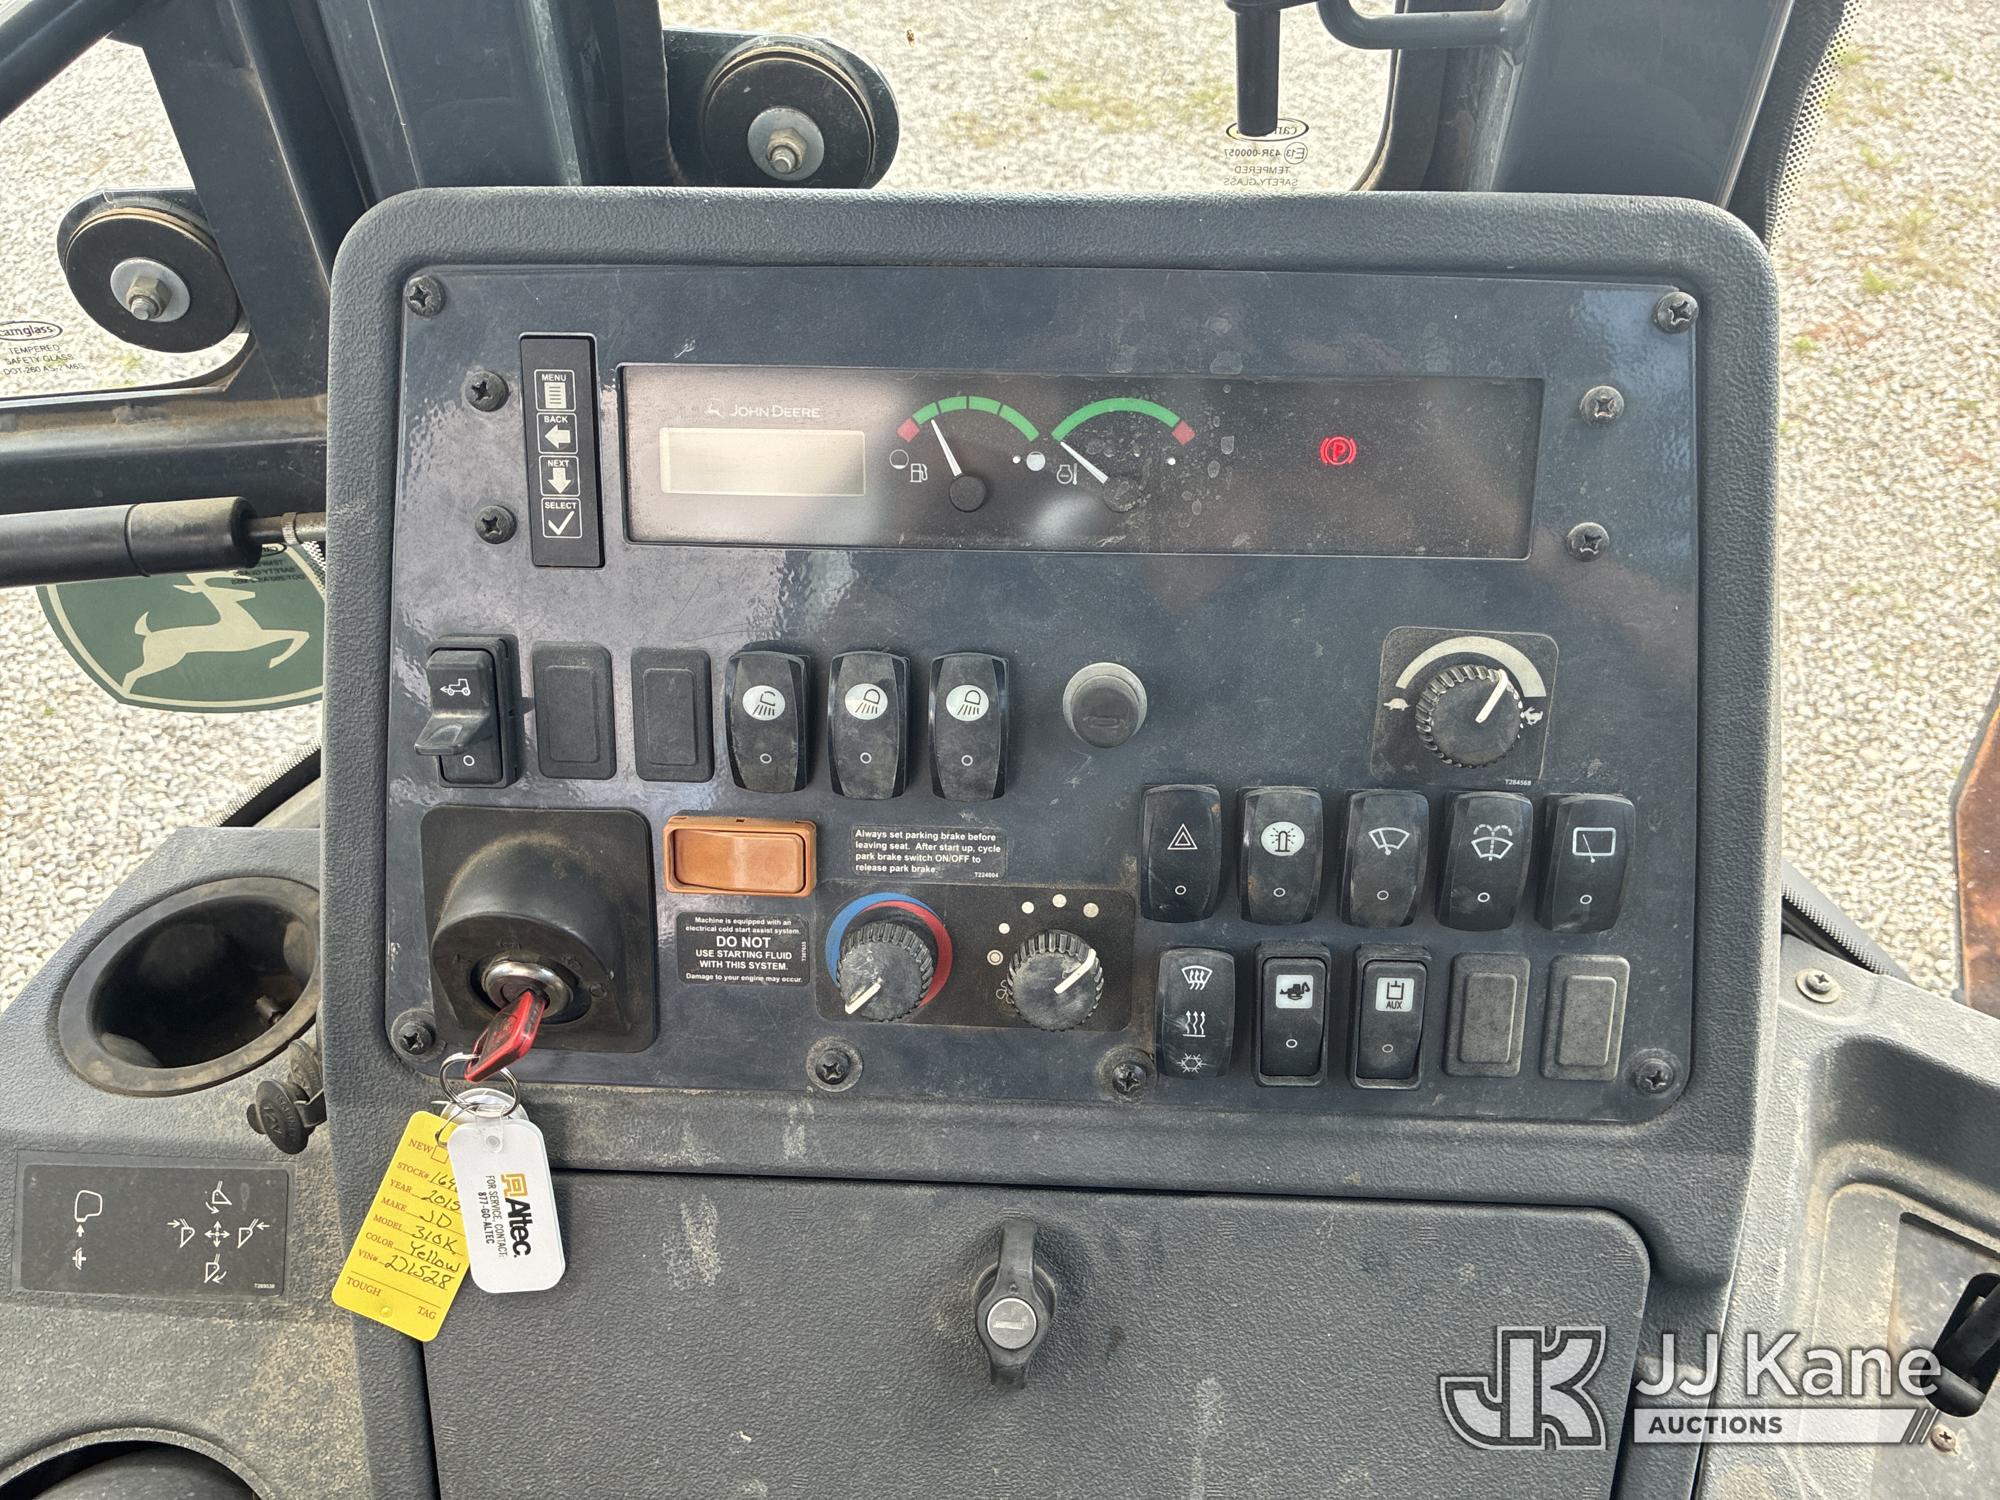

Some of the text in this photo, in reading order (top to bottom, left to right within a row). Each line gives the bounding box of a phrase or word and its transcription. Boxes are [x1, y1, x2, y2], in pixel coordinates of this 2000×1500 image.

[8, 344, 60, 355] TEMPERED
[5, 354, 74, 365] SAFETY GLASS
[542, 374, 567, 382] MENU
[544, 415, 568, 424] BACK
[548, 460, 569, 468] NEXT
[544, 502, 577, 510] SELECT
[855, 829, 997, 842] Always set parking brake before
[855, 840, 1001, 853] leaving seat. After start up, cycle
[855, 852, 981, 863] park brake switch ON/OFF to
[855, 864, 937, 873] release park brake.
[694, 916, 723, 924] Machine
[733, 918, 765, 926] equipped
[752, 926, 773, 934] assist
[774, 927, 801, 936] system.
[716, 935, 771, 948] DO NOT
[695, 949, 714, 958] USE
[717, 949, 763, 959] STARTING
[765, 951, 792, 960] FLUID
[699, 960, 788, 971] WITH THIS SYSTEM.
[686, 972, 714, 980] Damage
[724, 974, 739, 982] your
[741, 974, 764, 982] engine
[1386, 1001, 1403, 1009] AUX
[408, 1138, 434, 1154] NEW
[396, 1161, 429, 1180] STOCK#
[389, 1178, 412, 1194] YEAR
[485, 1175, 497, 1190] FOR
[381, 1197, 407, 1213] MAKE
[421, 1188, 462, 1212] 2015
[373, 1213, 402, 1231] MODEL
[419, 1209, 453, 1229] JD
[478, 1191, 495, 1245] 877-GO-ALTEC
[365, 1231, 394, 1249] COLOR
[358, 1249, 379, 1264] VIN#
[410, 1241, 462, 1273] Yellow
[345, 1276, 382, 1297] TOUGH
[417, 1305, 437, 1321] TAG
